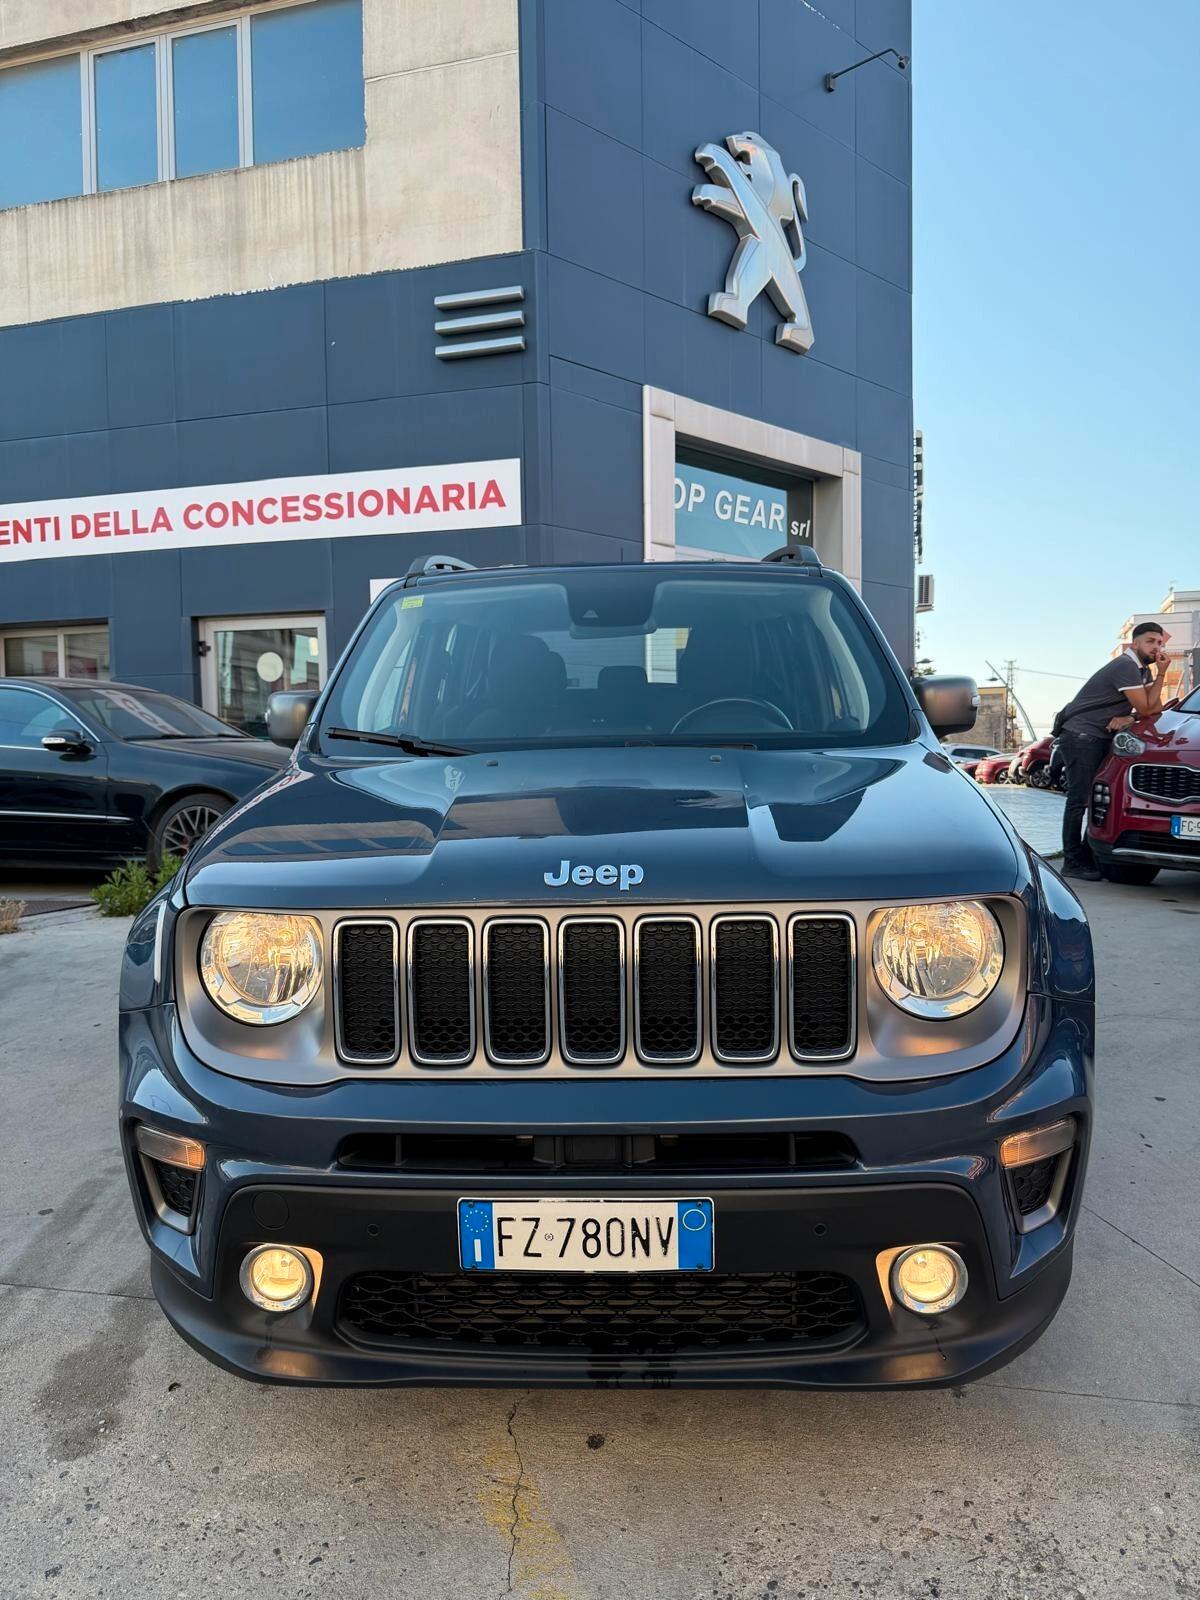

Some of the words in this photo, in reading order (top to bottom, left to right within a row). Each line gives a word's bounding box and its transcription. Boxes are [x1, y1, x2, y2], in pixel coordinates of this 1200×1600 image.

[0, 516, 61, 546] ENTI
[71, 506, 174, 540] DELLA
[182, 479, 507, 531] CONCESSIONARIA
[714, 490, 785, 532] GEAR
[790, 519, 811, 538] srl
[543, 859, 644, 891] Jeep
